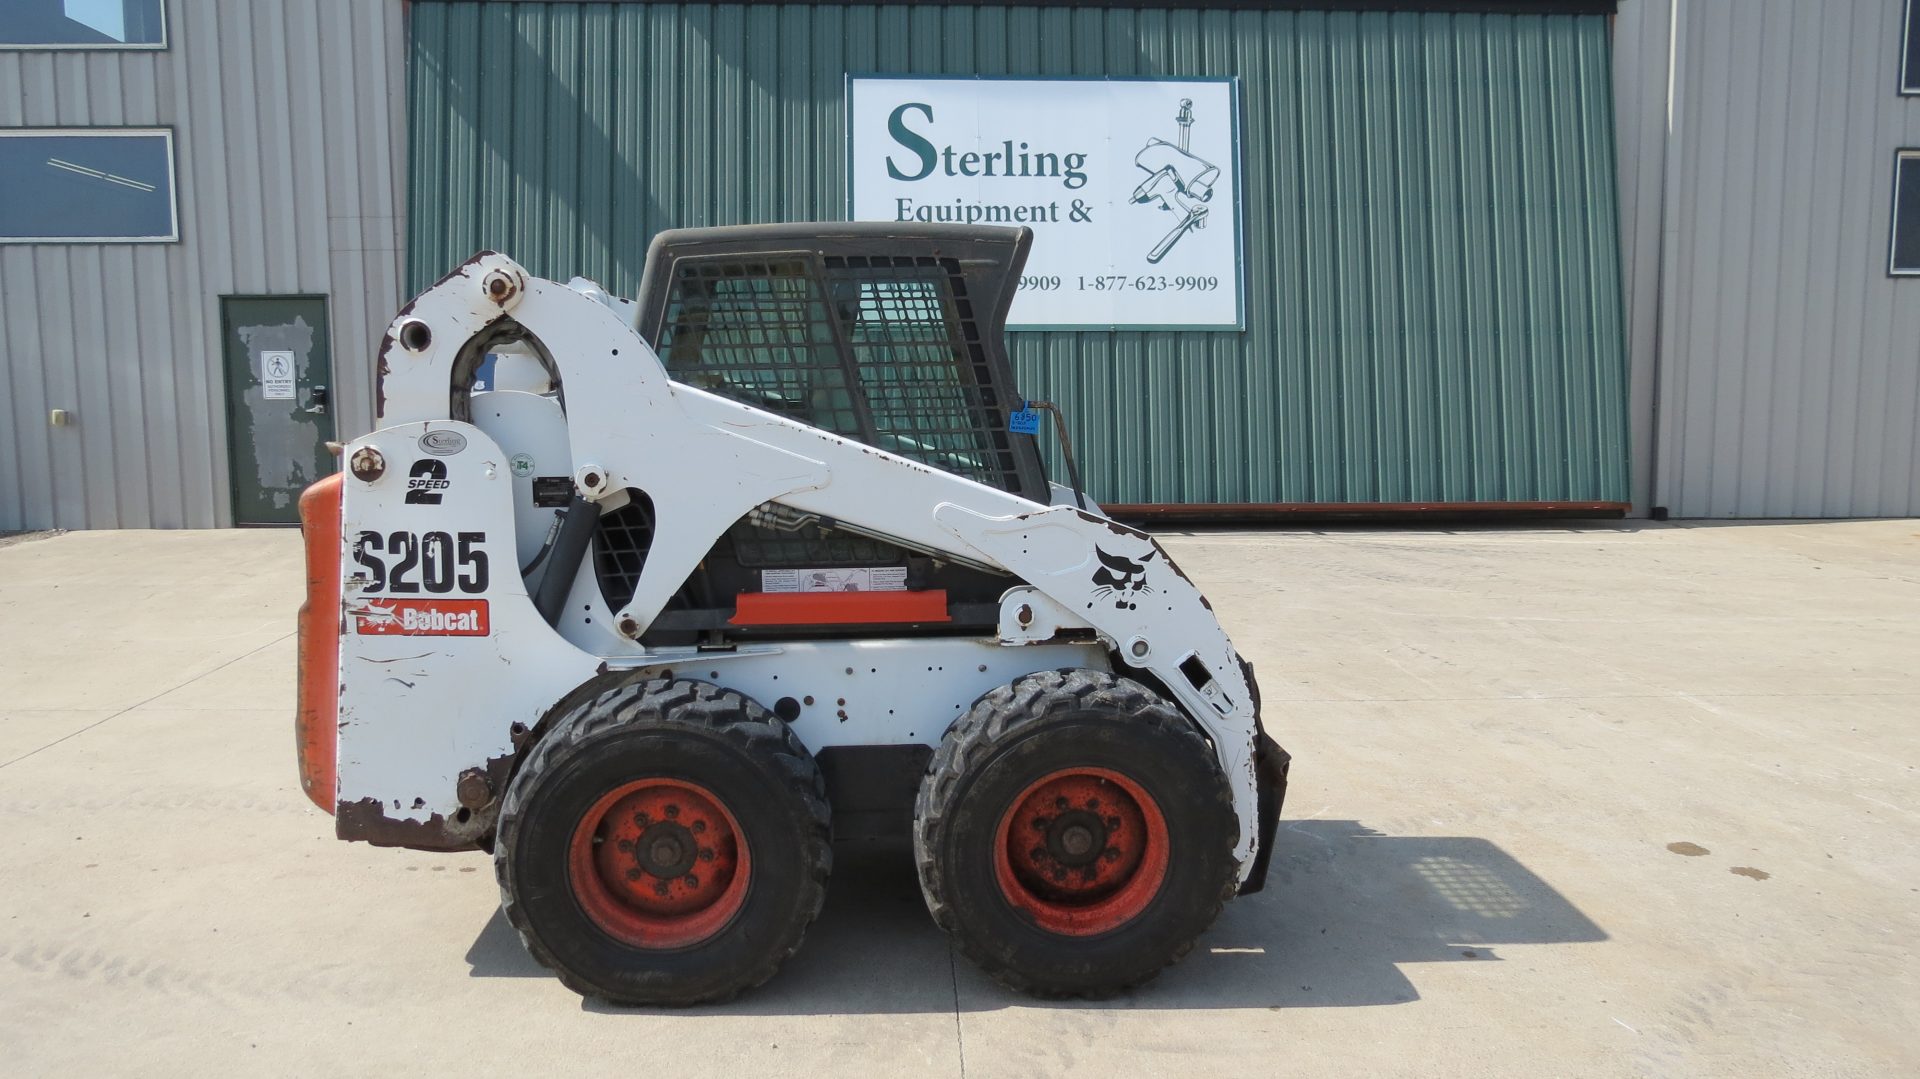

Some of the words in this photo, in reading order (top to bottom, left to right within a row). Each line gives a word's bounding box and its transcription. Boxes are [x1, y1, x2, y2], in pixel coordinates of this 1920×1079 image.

[885, 102, 1088, 189] Sterling
[895, 197, 1059, 224] Equipment
[1068, 198, 1093, 223] &
[1077, 275, 1218, 291] 1-877-623-9909
[405, 458, 448, 505] 2
[407, 479, 451, 489] SPEED
[353, 530, 489, 593] S205
[403, 607, 479, 632] Bobcat
